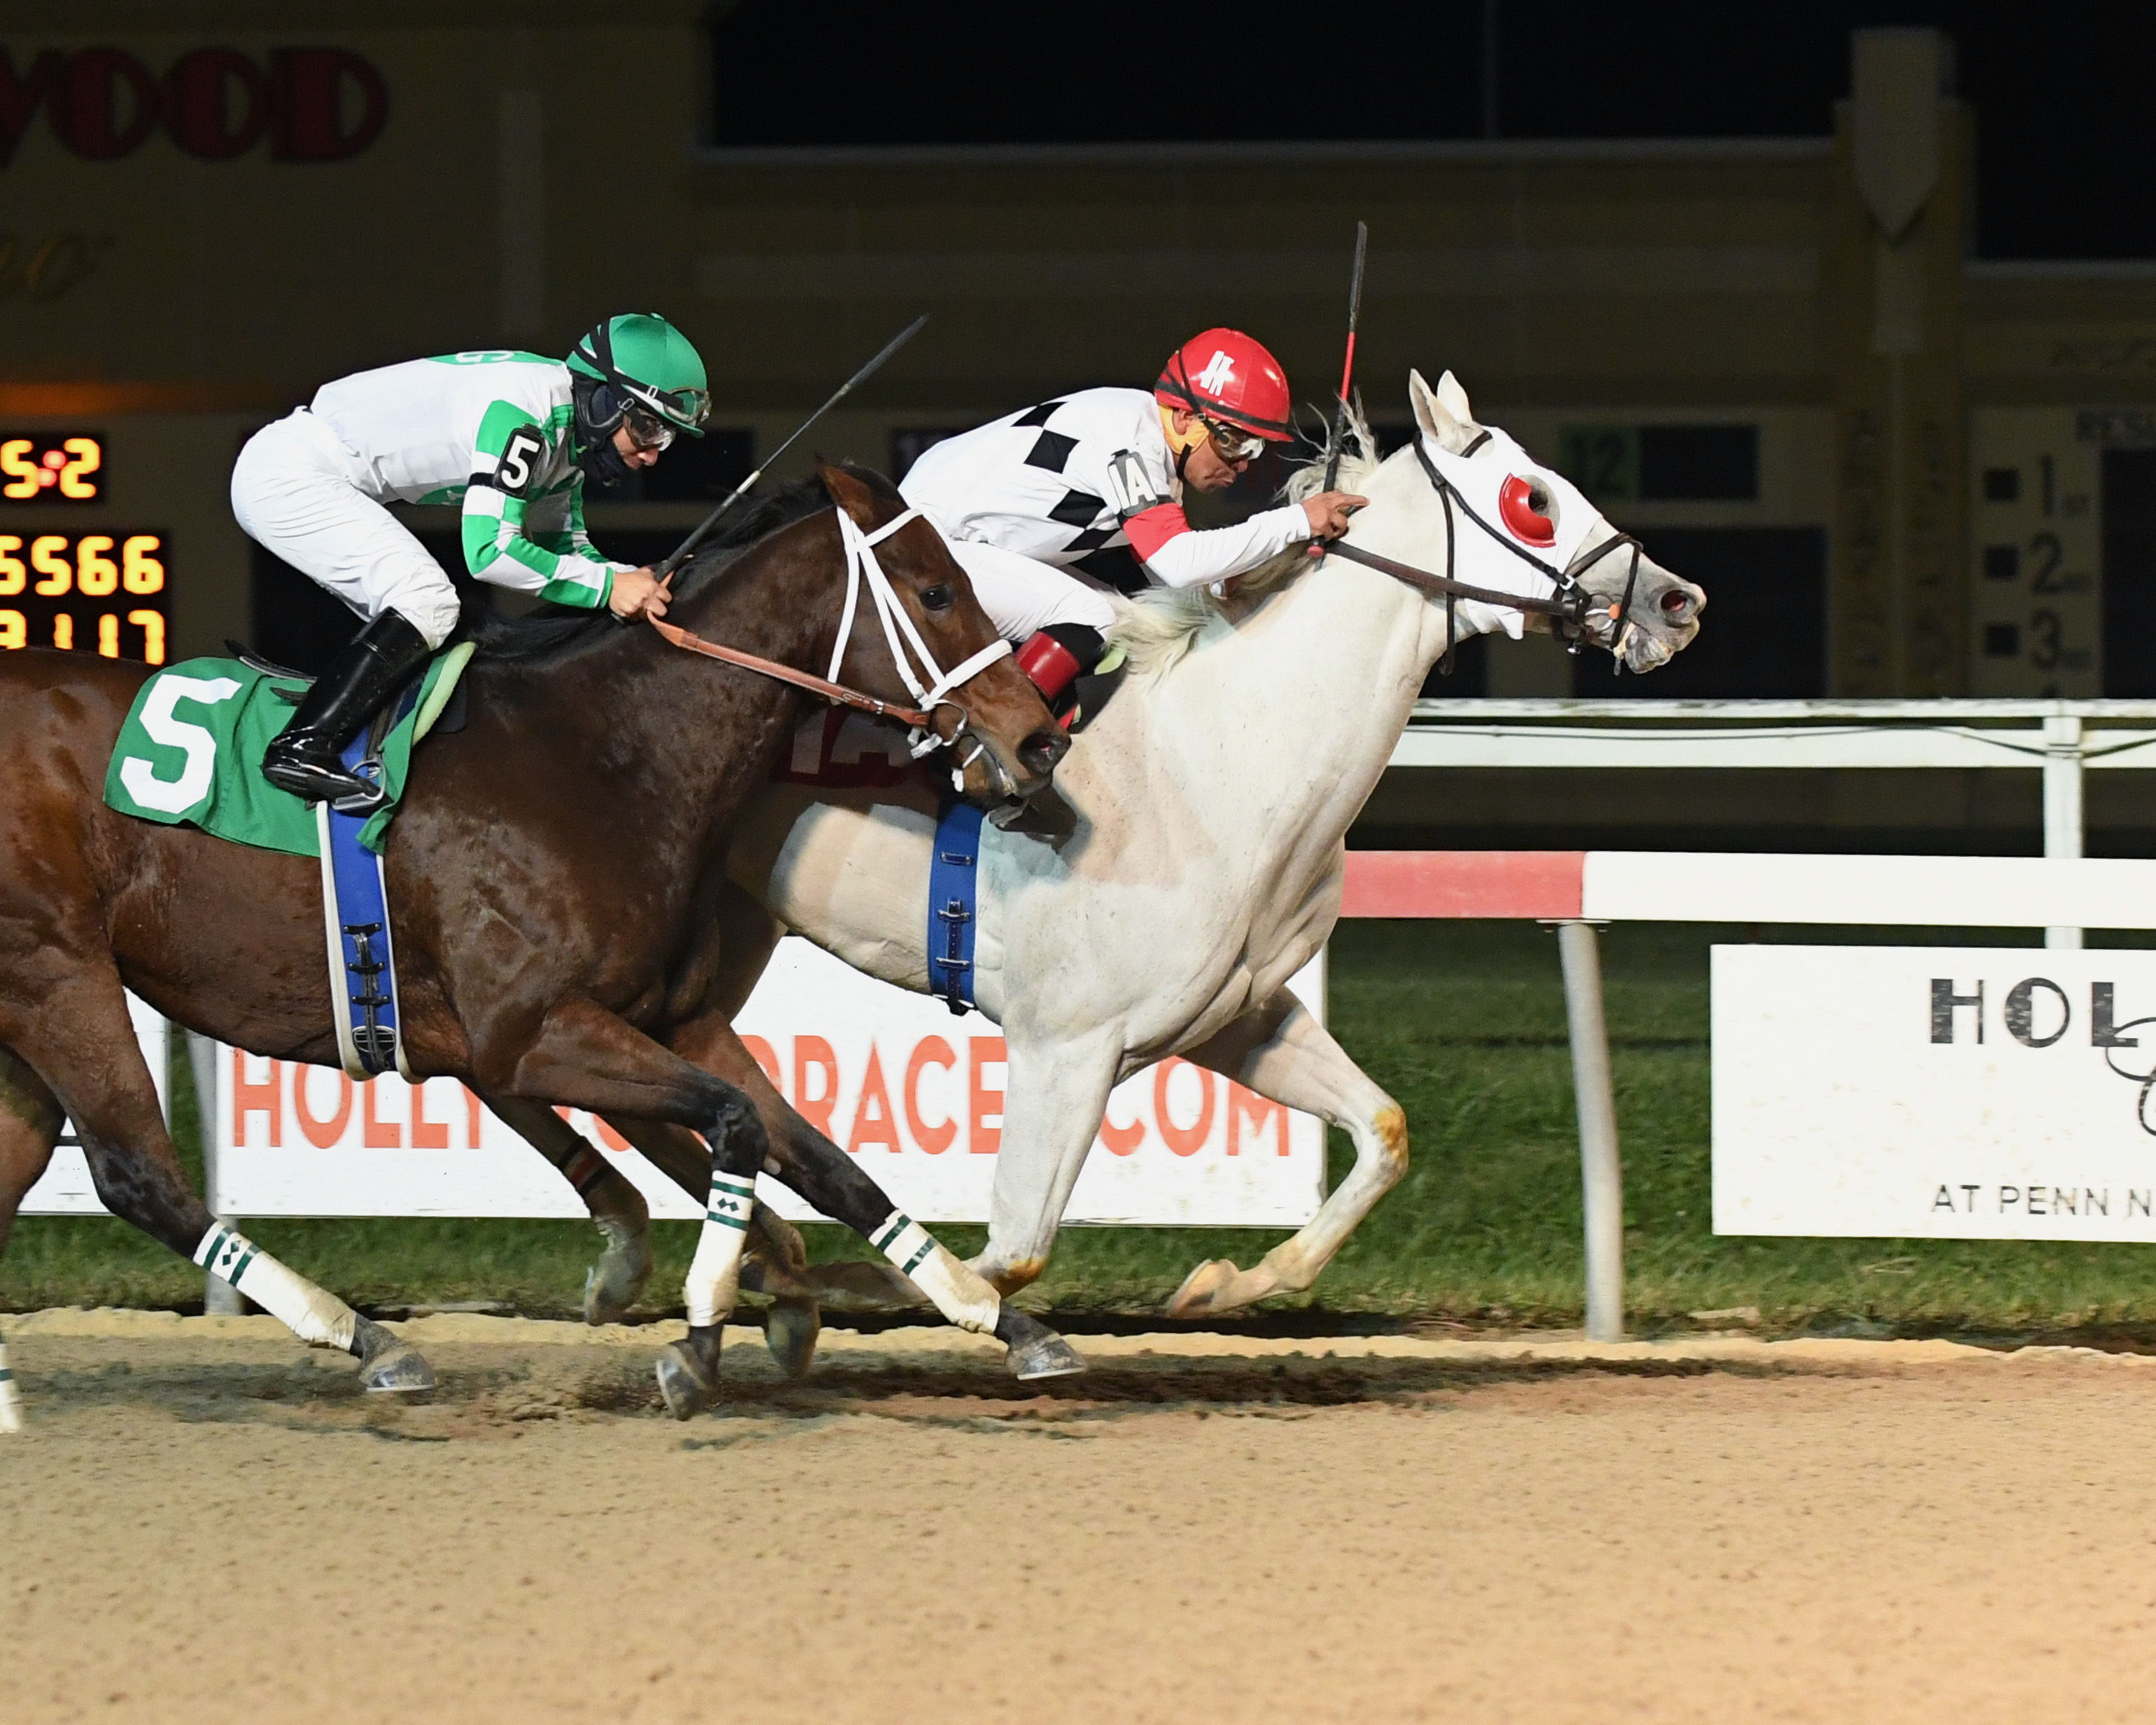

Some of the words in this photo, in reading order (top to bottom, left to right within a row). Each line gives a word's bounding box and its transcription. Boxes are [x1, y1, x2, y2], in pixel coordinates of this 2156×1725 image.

[501, 434, 540, 489] 5
[119, 673, 243, 815] 5
[1931, 1184, 1981, 1213] AT
[1999, 1185, 2109, 1217] PENN
